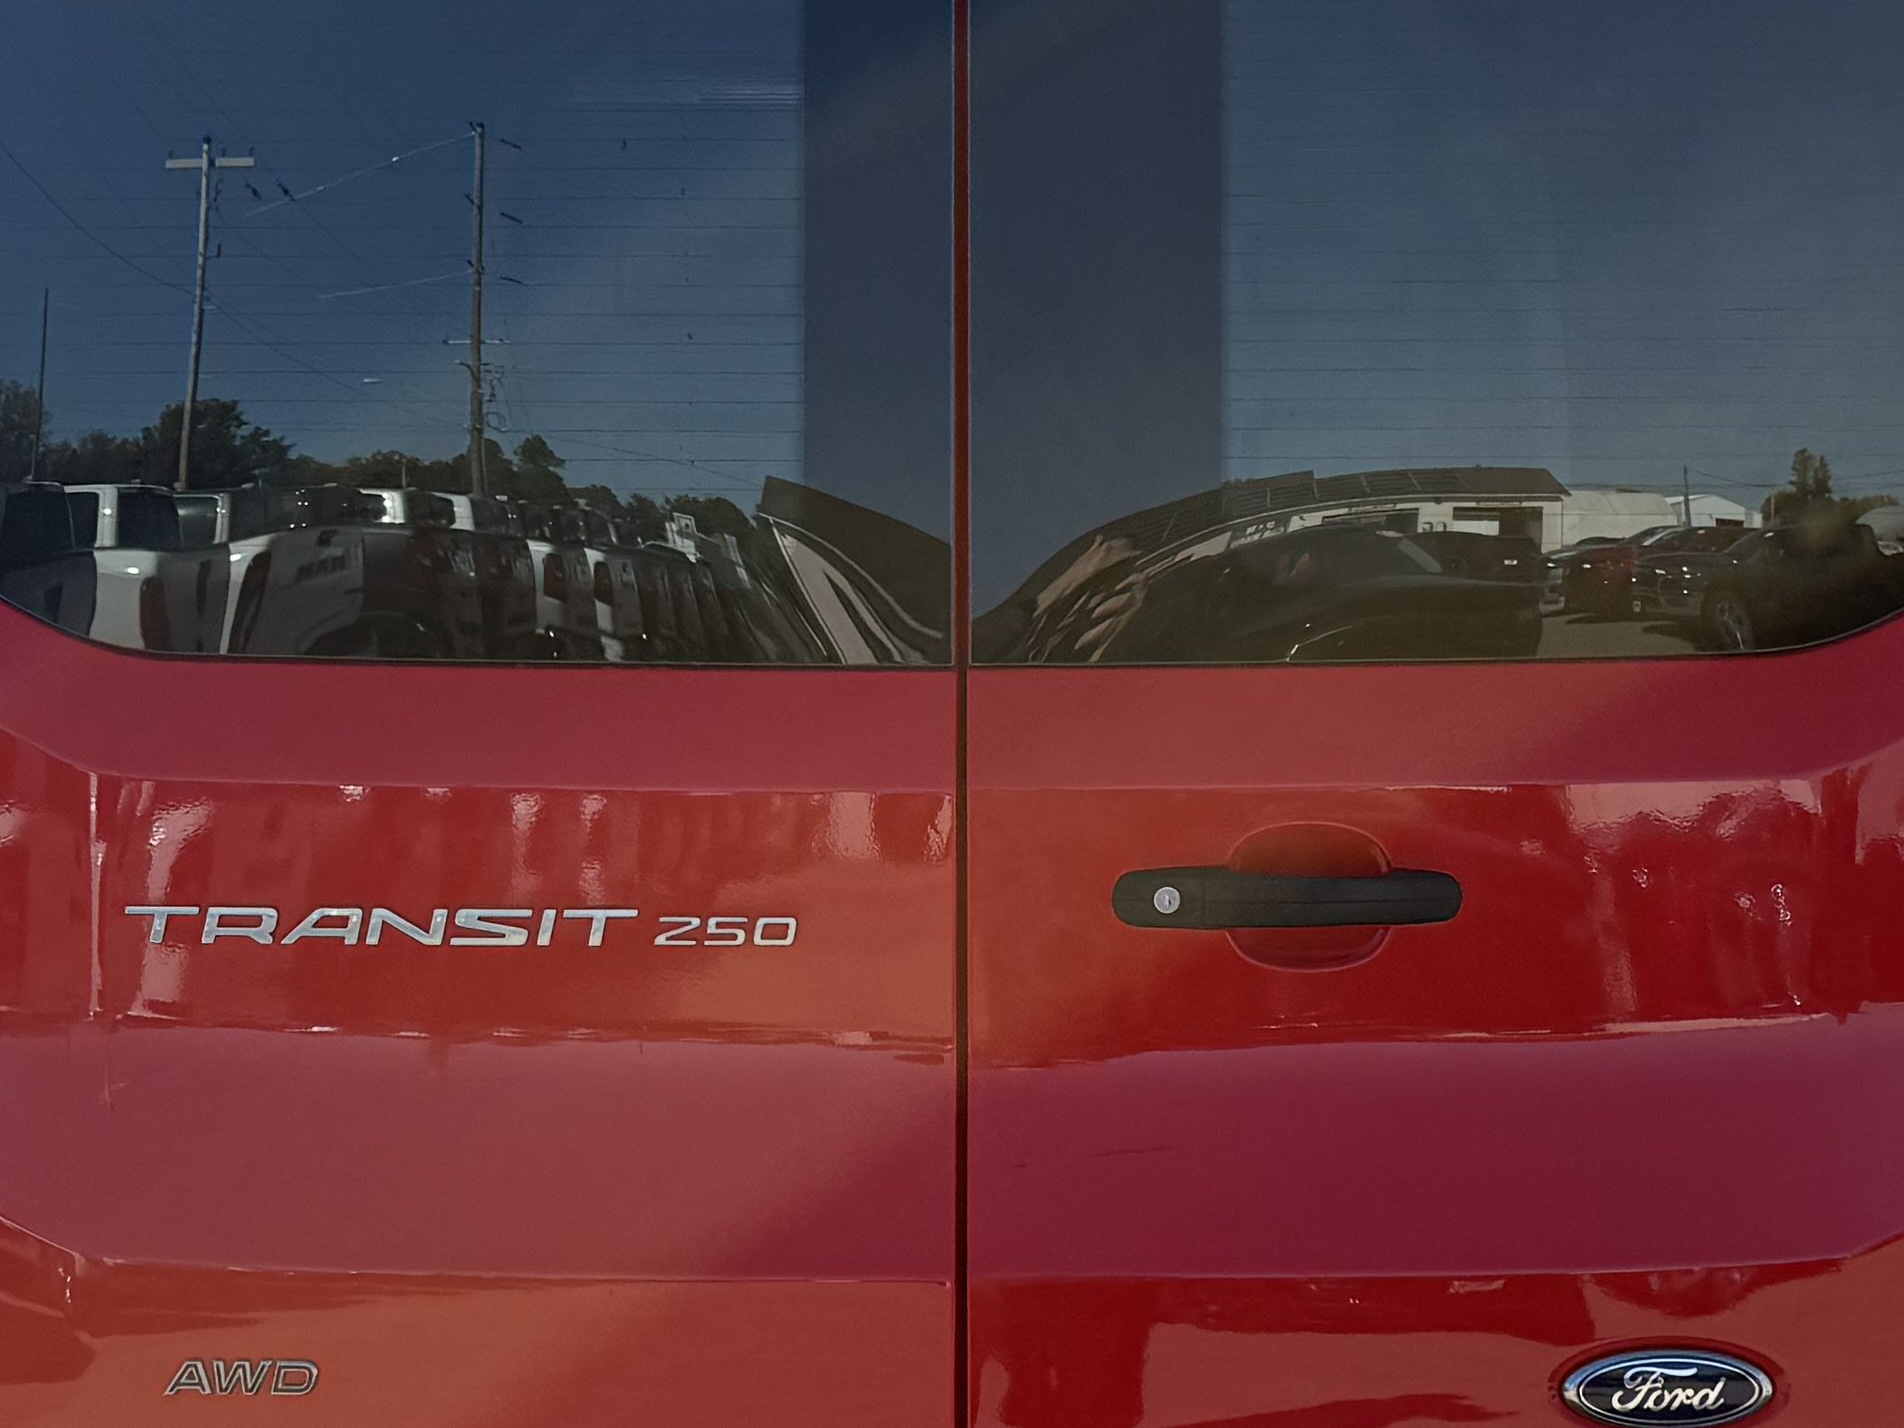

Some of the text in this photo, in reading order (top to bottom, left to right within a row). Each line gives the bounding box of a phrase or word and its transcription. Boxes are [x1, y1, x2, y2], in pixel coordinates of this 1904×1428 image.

[123, 905, 798, 948] TRANSIT 250
[162, 1359, 319, 1396] AWD
[1611, 1365, 1730, 1412] Ford
